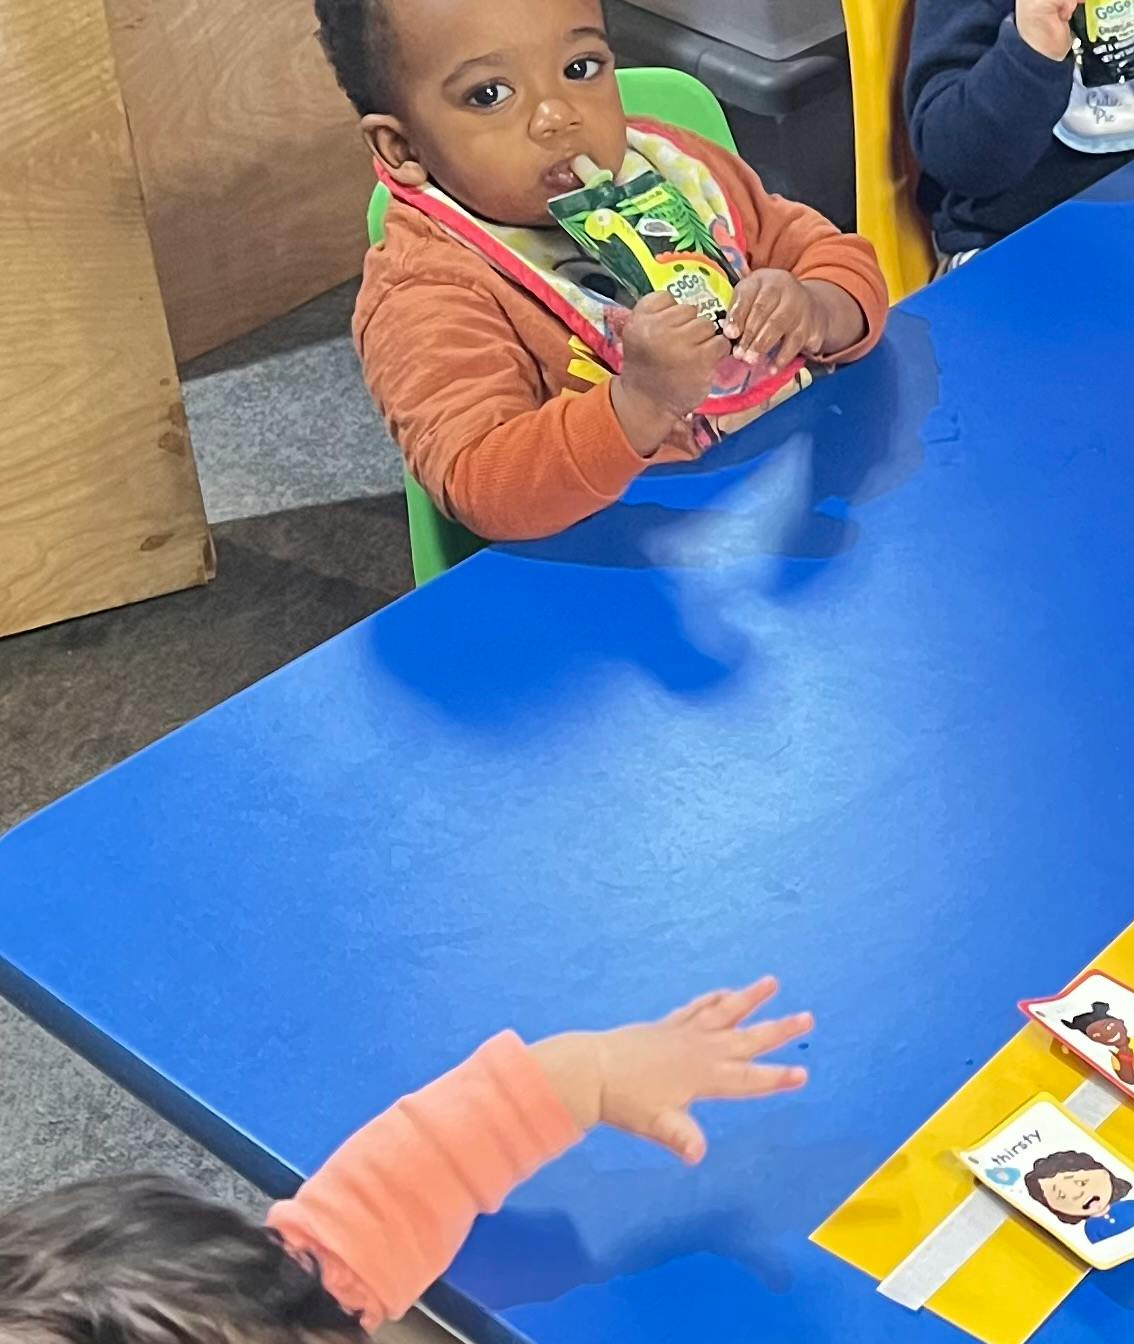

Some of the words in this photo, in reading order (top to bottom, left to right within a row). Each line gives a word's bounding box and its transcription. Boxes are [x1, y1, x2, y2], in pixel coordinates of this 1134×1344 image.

[1095, 0, 1132, 21] GoGo
[666, 274, 700, 299] GoGo
[991, 1129, 1042, 1166] thirsty
